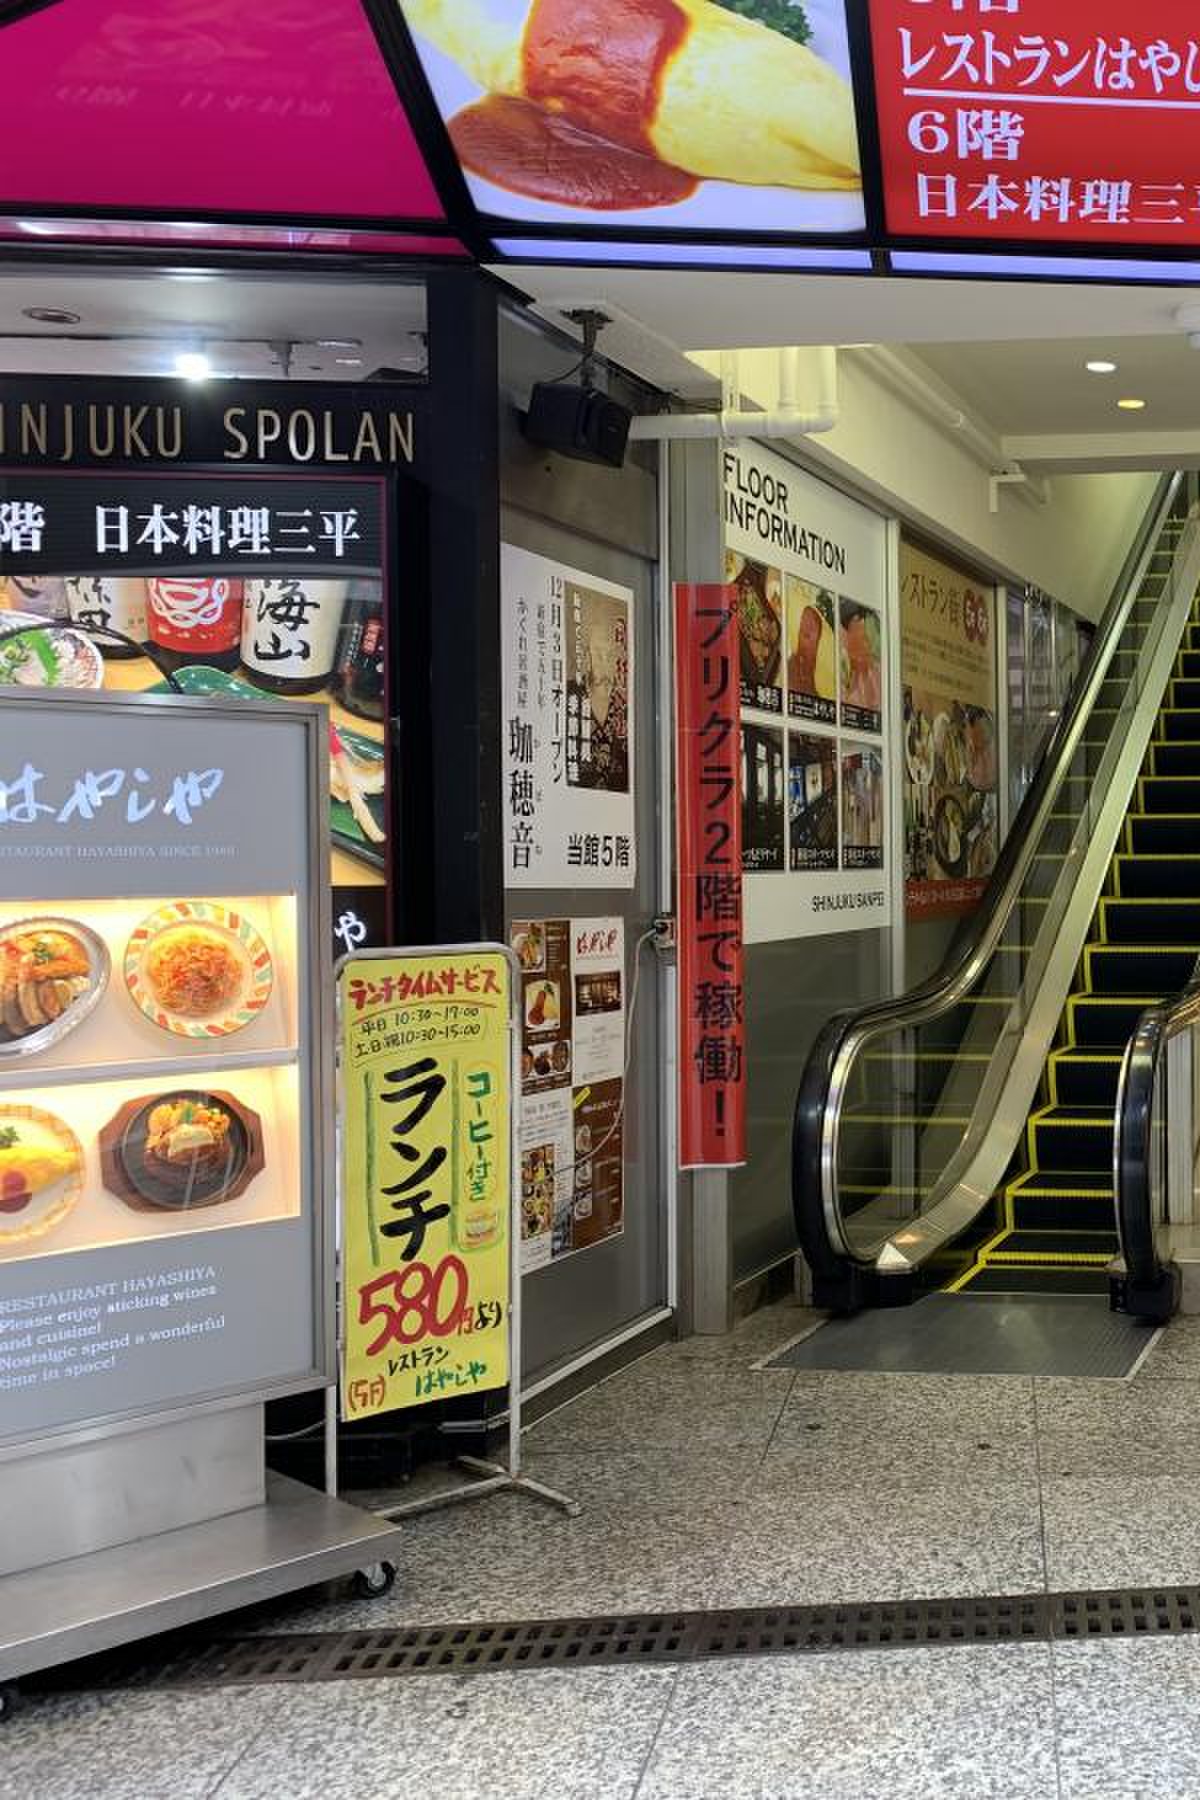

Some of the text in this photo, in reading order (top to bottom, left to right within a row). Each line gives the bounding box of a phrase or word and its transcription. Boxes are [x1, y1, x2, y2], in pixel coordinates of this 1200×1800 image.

[907, 108, 1025, 161] 6階
[223, 407, 415, 463] SPOLAN
[723, 453, 789, 512] FLOOR
[96, 503, 361, 558] 日本料理三平
[723, 490, 846, 575] INFORMATION
[567, 833, 630, 868] 当館5階
[348, 964, 502, 1010] ランチタイムサービス
[380, 1057, 451, 1262] ランチ
[122, 1265, 217, 1294] HAYASHIYA
[81, 1333, 130, 1358] spend
[148, 1314, 226, 1342] wonderful
[388, 1345, 449, 1377] レストラン
[415, 1360, 488, 1397] はやしや
